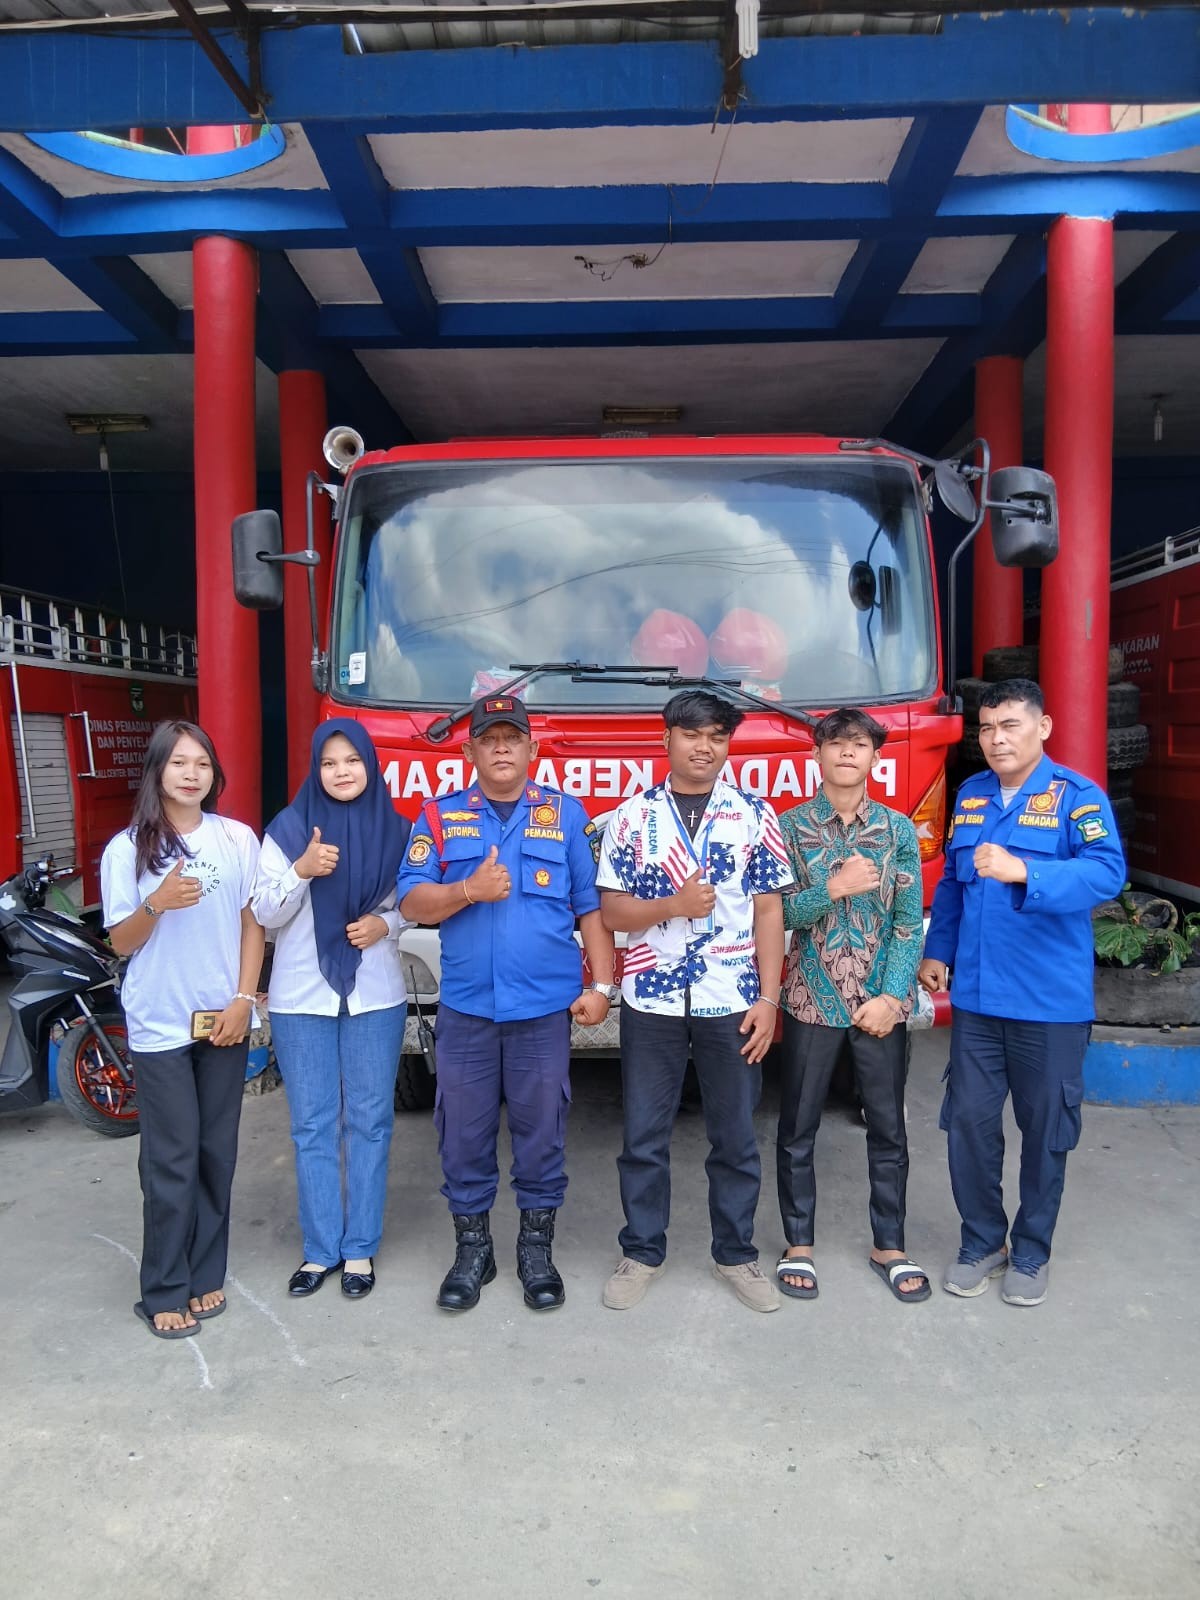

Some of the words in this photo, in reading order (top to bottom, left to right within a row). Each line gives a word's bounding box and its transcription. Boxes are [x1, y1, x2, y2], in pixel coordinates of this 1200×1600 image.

[97, 736, 116, 749] DAN
[1018, 815, 1059, 828] PEMADAM
[447, 826, 480, 838] SITOMPUL
[524, 828, 564, 842] PEMADAM
